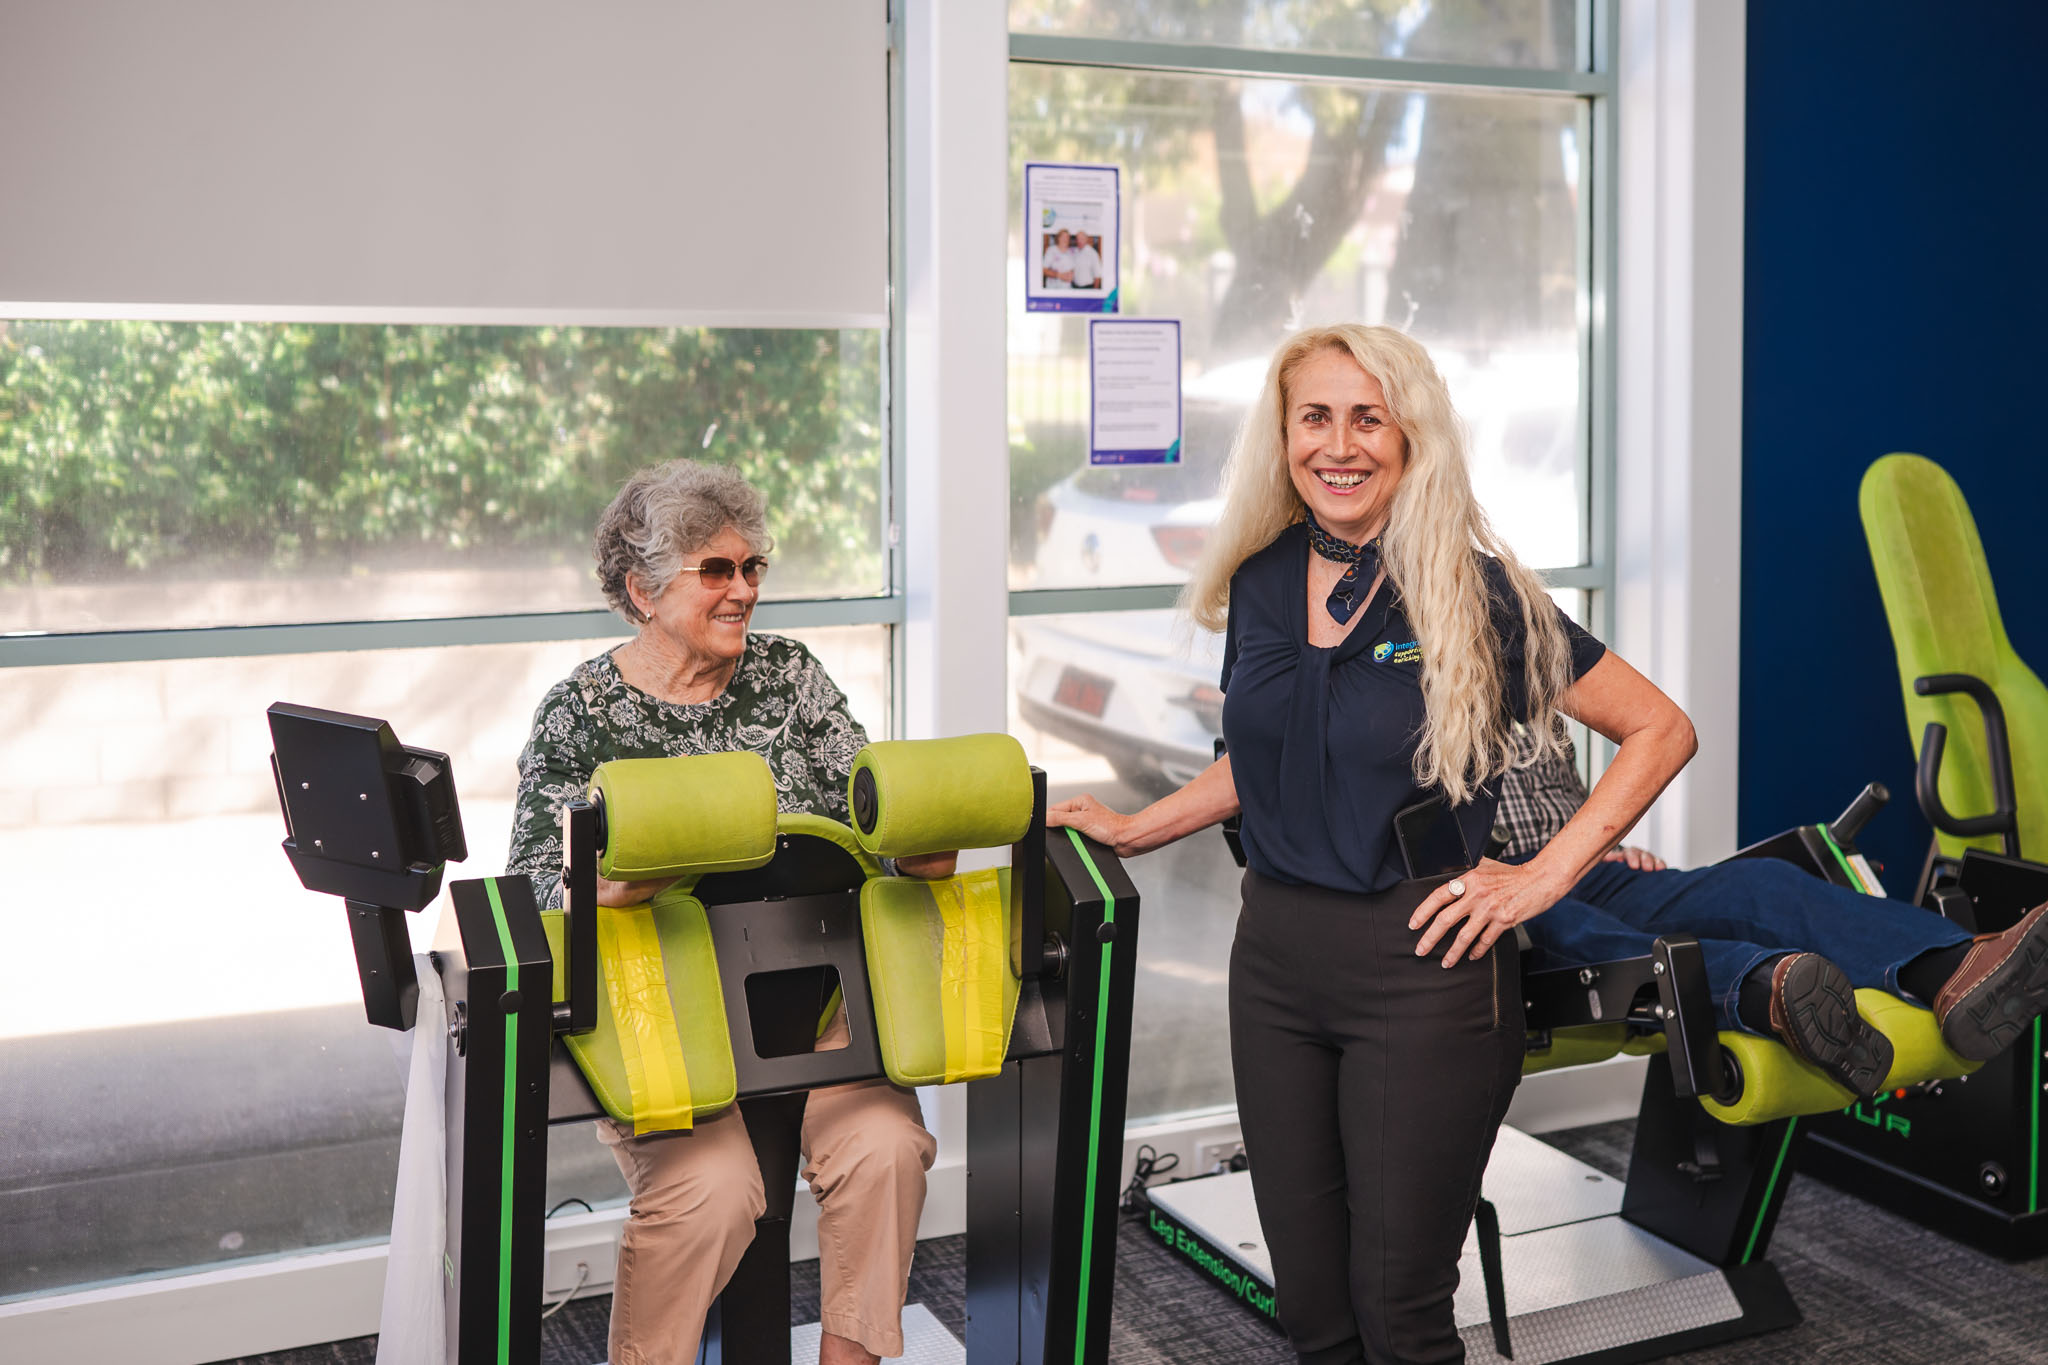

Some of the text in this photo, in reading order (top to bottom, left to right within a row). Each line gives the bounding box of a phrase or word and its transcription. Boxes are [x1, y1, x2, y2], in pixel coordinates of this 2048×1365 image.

[1843, 1101, 1912, 1138] UR
[1150, 1208, 1276, 1319] Leg Extension/Curl
